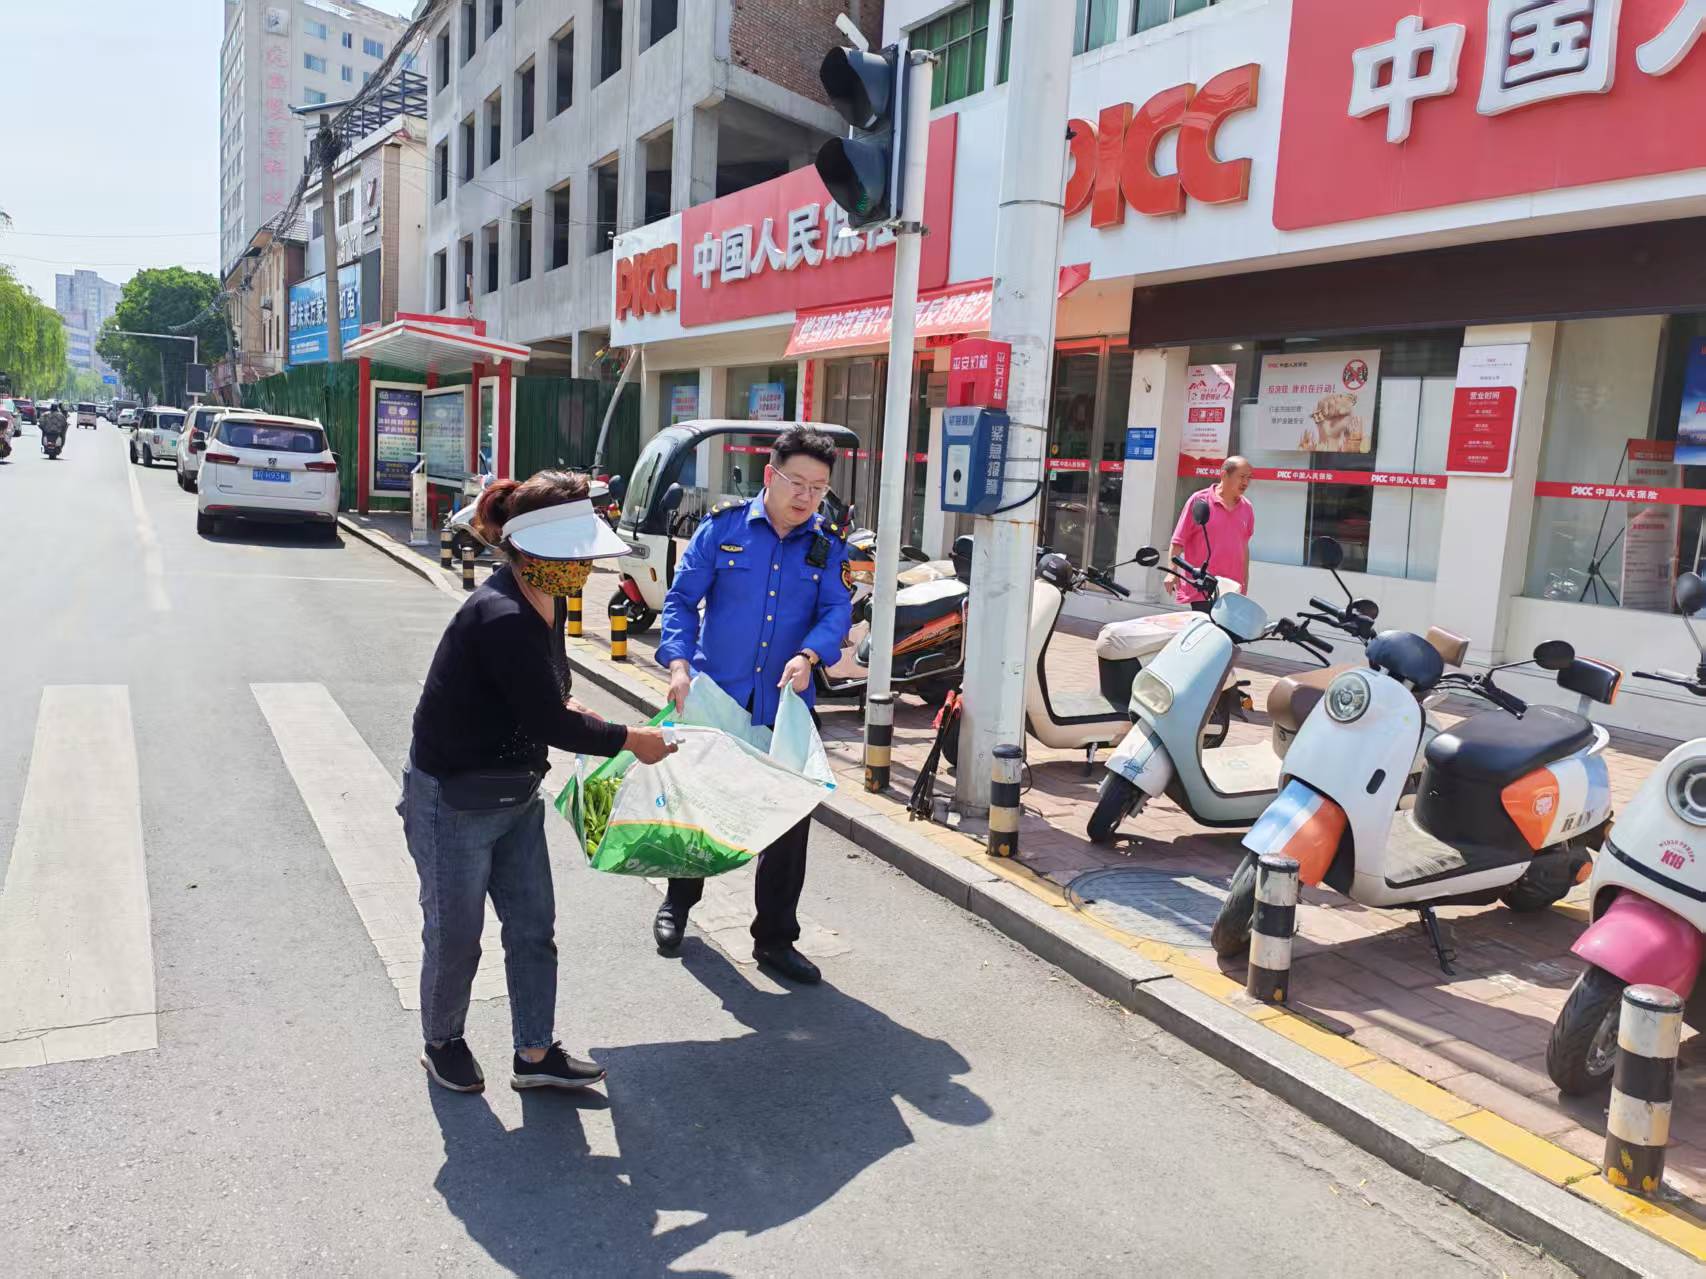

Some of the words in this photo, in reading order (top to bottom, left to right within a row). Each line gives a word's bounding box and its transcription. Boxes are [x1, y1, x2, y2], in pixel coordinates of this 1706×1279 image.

[616, 243, 678, 321] PICC
[1469, 391, 1501, 400] 营业时间
[1277, 470, 1292, 479] PICC
[1293, 472, 1333, 481] 中国人民保险
[1371, 474, 1388, 483] PICC
[1389, 475, 1436, 486] 中国人民保险
[1571, 485, 1594, 496] PICC
[1595, 488, 1659, 500] 中国人民保险
[1660, 850, 1685, 870] K18
